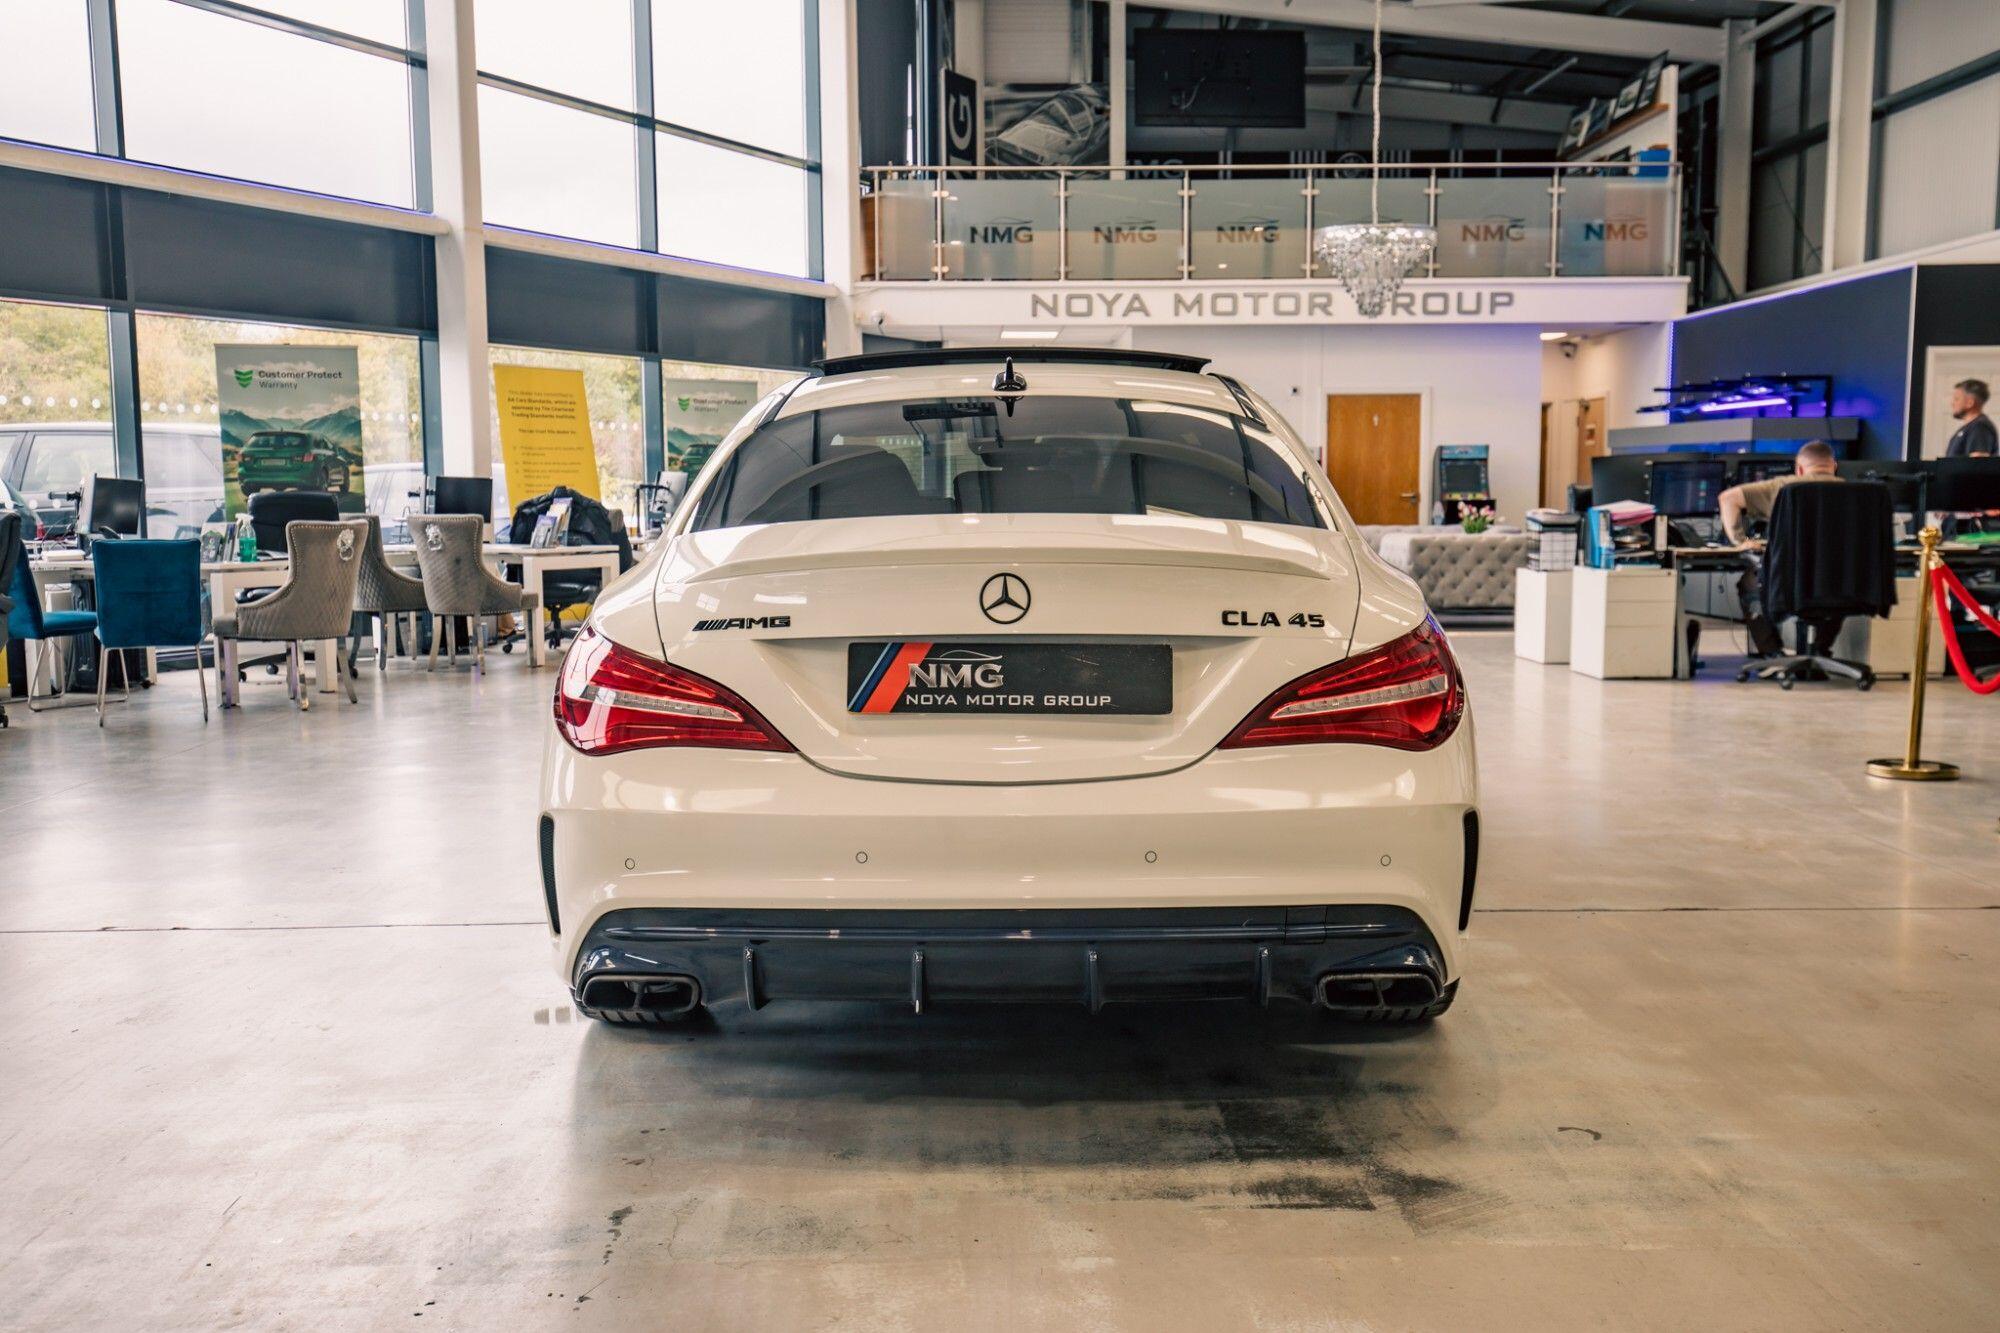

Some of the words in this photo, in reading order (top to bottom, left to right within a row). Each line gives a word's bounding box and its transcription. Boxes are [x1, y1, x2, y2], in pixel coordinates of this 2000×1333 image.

[1127, 158, 1185, 179] MG
[970, 225, 1033, 244] NMG
[1093, 225, 1158, 244] NMG
[1216, 225, 1281, 244] NMG
[1461, 223, 1525, 242] NMG
[1584, 223, 1648, 242] NMG
[1031, 292, 1151, 318] NOYA
[1174, 292, 1333, 317] MOTOR
[258, 370, 305, 379] Customer
[307, 370, 343, 379] Protect
[259, 381, 298, 390] Warranty
[723, 616, 791, 630] AMG
[1221, 610, 1281, 627] CLA
[1288, 612, 1325, 628] 45
[907, 662, 1004, 689] NMG
[906, 694, 957, 706] NOYA
[966, 694, 1035, 706] MOTOR
[1043, 695, 1112, 707] GROUP
